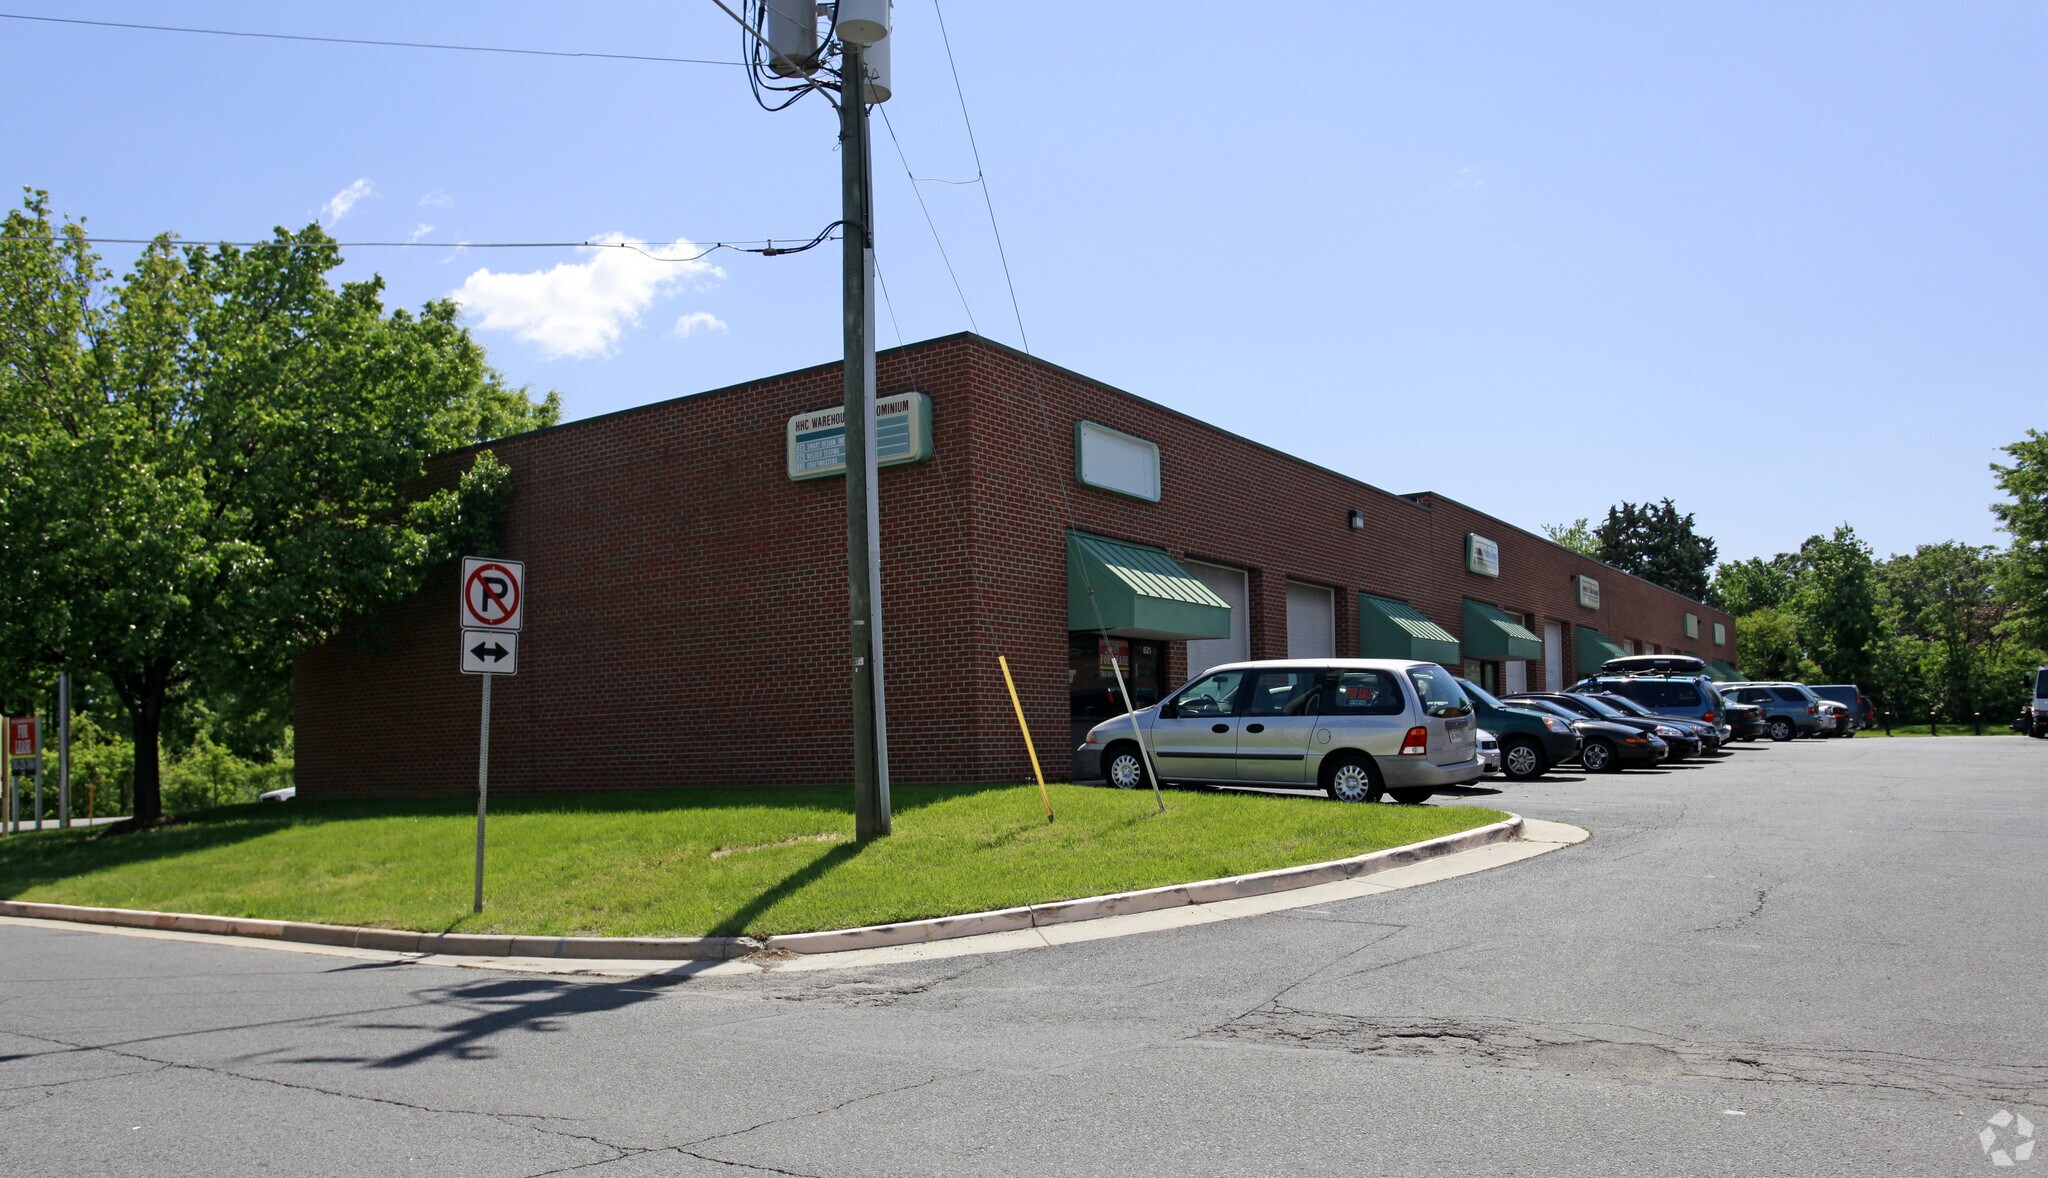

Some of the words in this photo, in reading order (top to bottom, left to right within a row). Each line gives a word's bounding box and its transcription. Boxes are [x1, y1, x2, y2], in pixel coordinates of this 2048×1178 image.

[795, 420, 809, 431] HHC
[812, 412, 845, 428] WAREHOU
[876, 400, 909, 416] OMINIUM
[807, 441, 821, 450] SMART
[821, 438, 836, 448] DESIGN
[823, 447, 839, 457] TESTING
[482, 576, 508, 612] P
